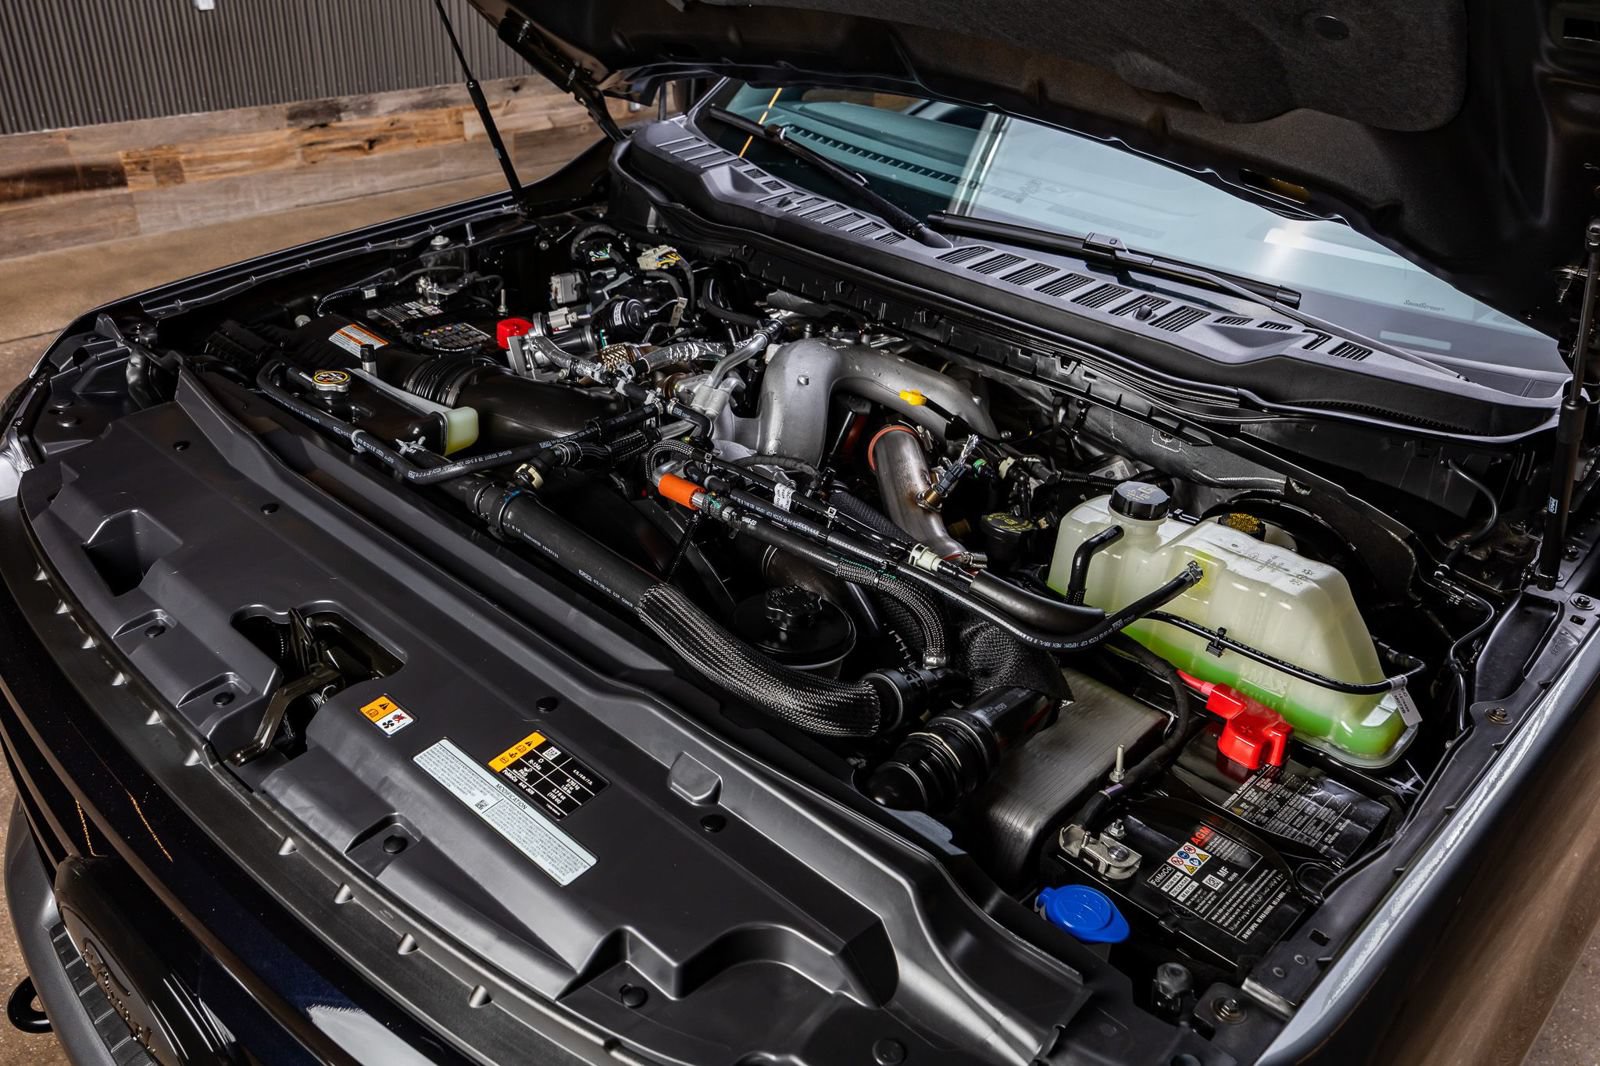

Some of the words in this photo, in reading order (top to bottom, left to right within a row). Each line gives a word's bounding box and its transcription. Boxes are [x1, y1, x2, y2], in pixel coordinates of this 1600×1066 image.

[496, 783, 528, 810] MODIFICATION
[1190, 825, 1213, 846] AGM
[1150, 865, 1172, 887] FoMoCo
